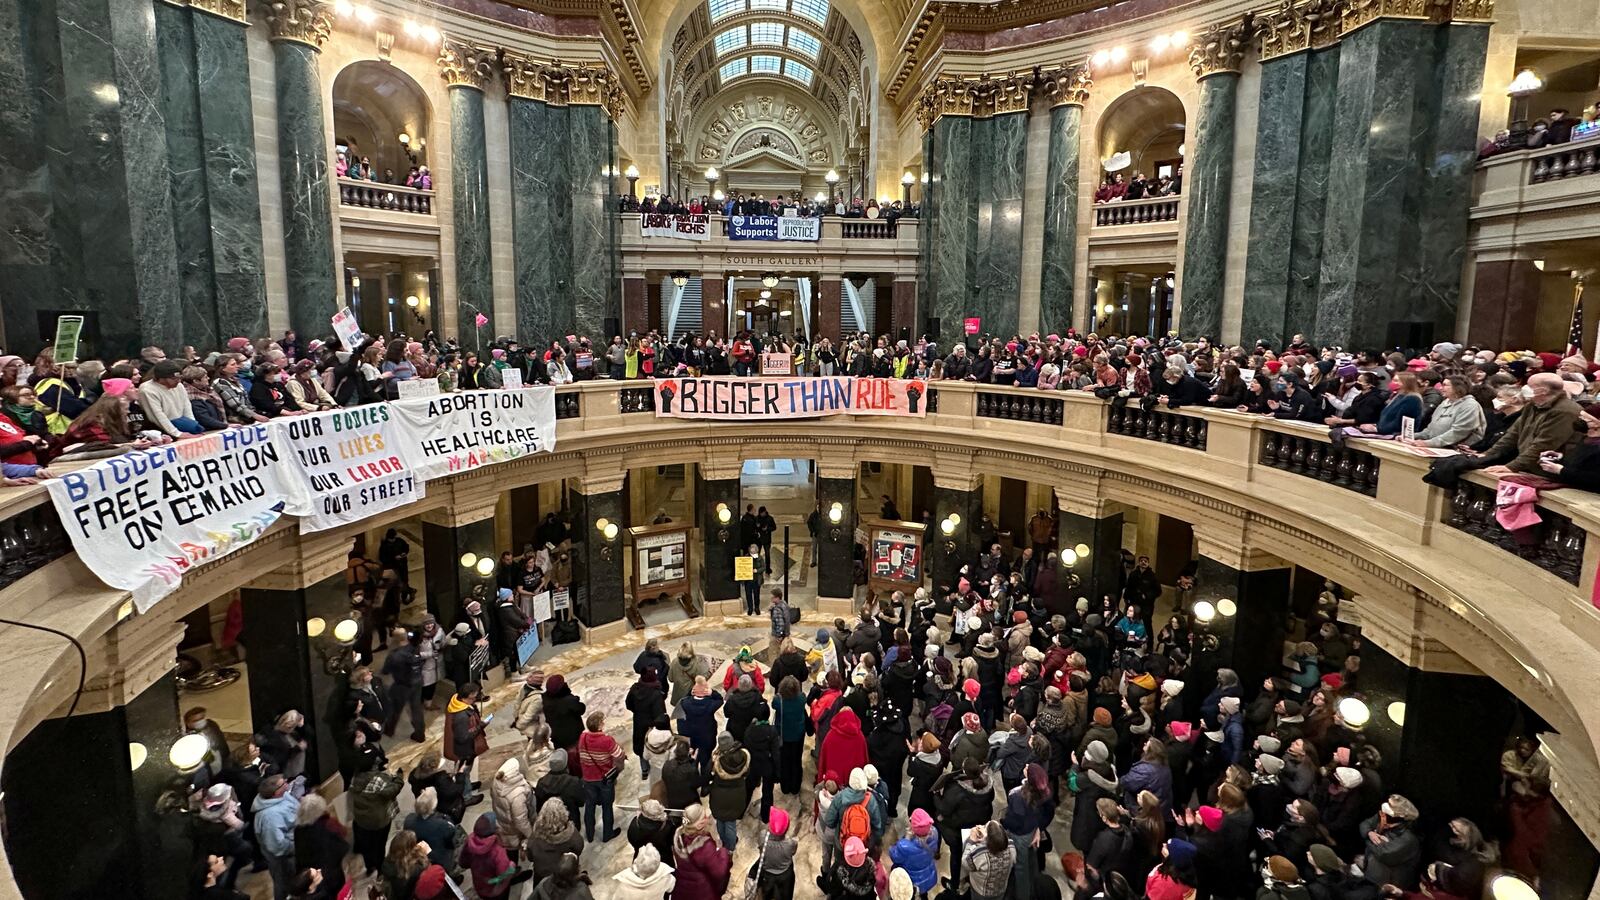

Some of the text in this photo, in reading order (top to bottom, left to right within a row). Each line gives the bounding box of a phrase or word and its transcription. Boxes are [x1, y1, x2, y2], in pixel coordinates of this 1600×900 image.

[676, 222, 705, 234] RIGHTS
[783, 219, 814, 227] REPRODUCTIVE
[783, 227, 814, 238] JUSTICE
[727, 256, 818, 265] SOUTH GALLERY
[428, 393, 523, 418] ABORTION
[681, 377, 898, 415] BIGGER THAN ROE
[289, 405, 389, 440] OUR BODIES
[471, 411, 492, 428] IS
[338, 433, 385, 459] LIVES
[421, 427, 539, 457] HEALTHCARE
[310, 456, 404, 492] OUR LABOR
[74, 442, 279, 539] FREE ABORTION
[124, 509, 163, 550] ON
[169, 475, 265, 525] DEMAND
[324, 494, 350, 515] OUR
